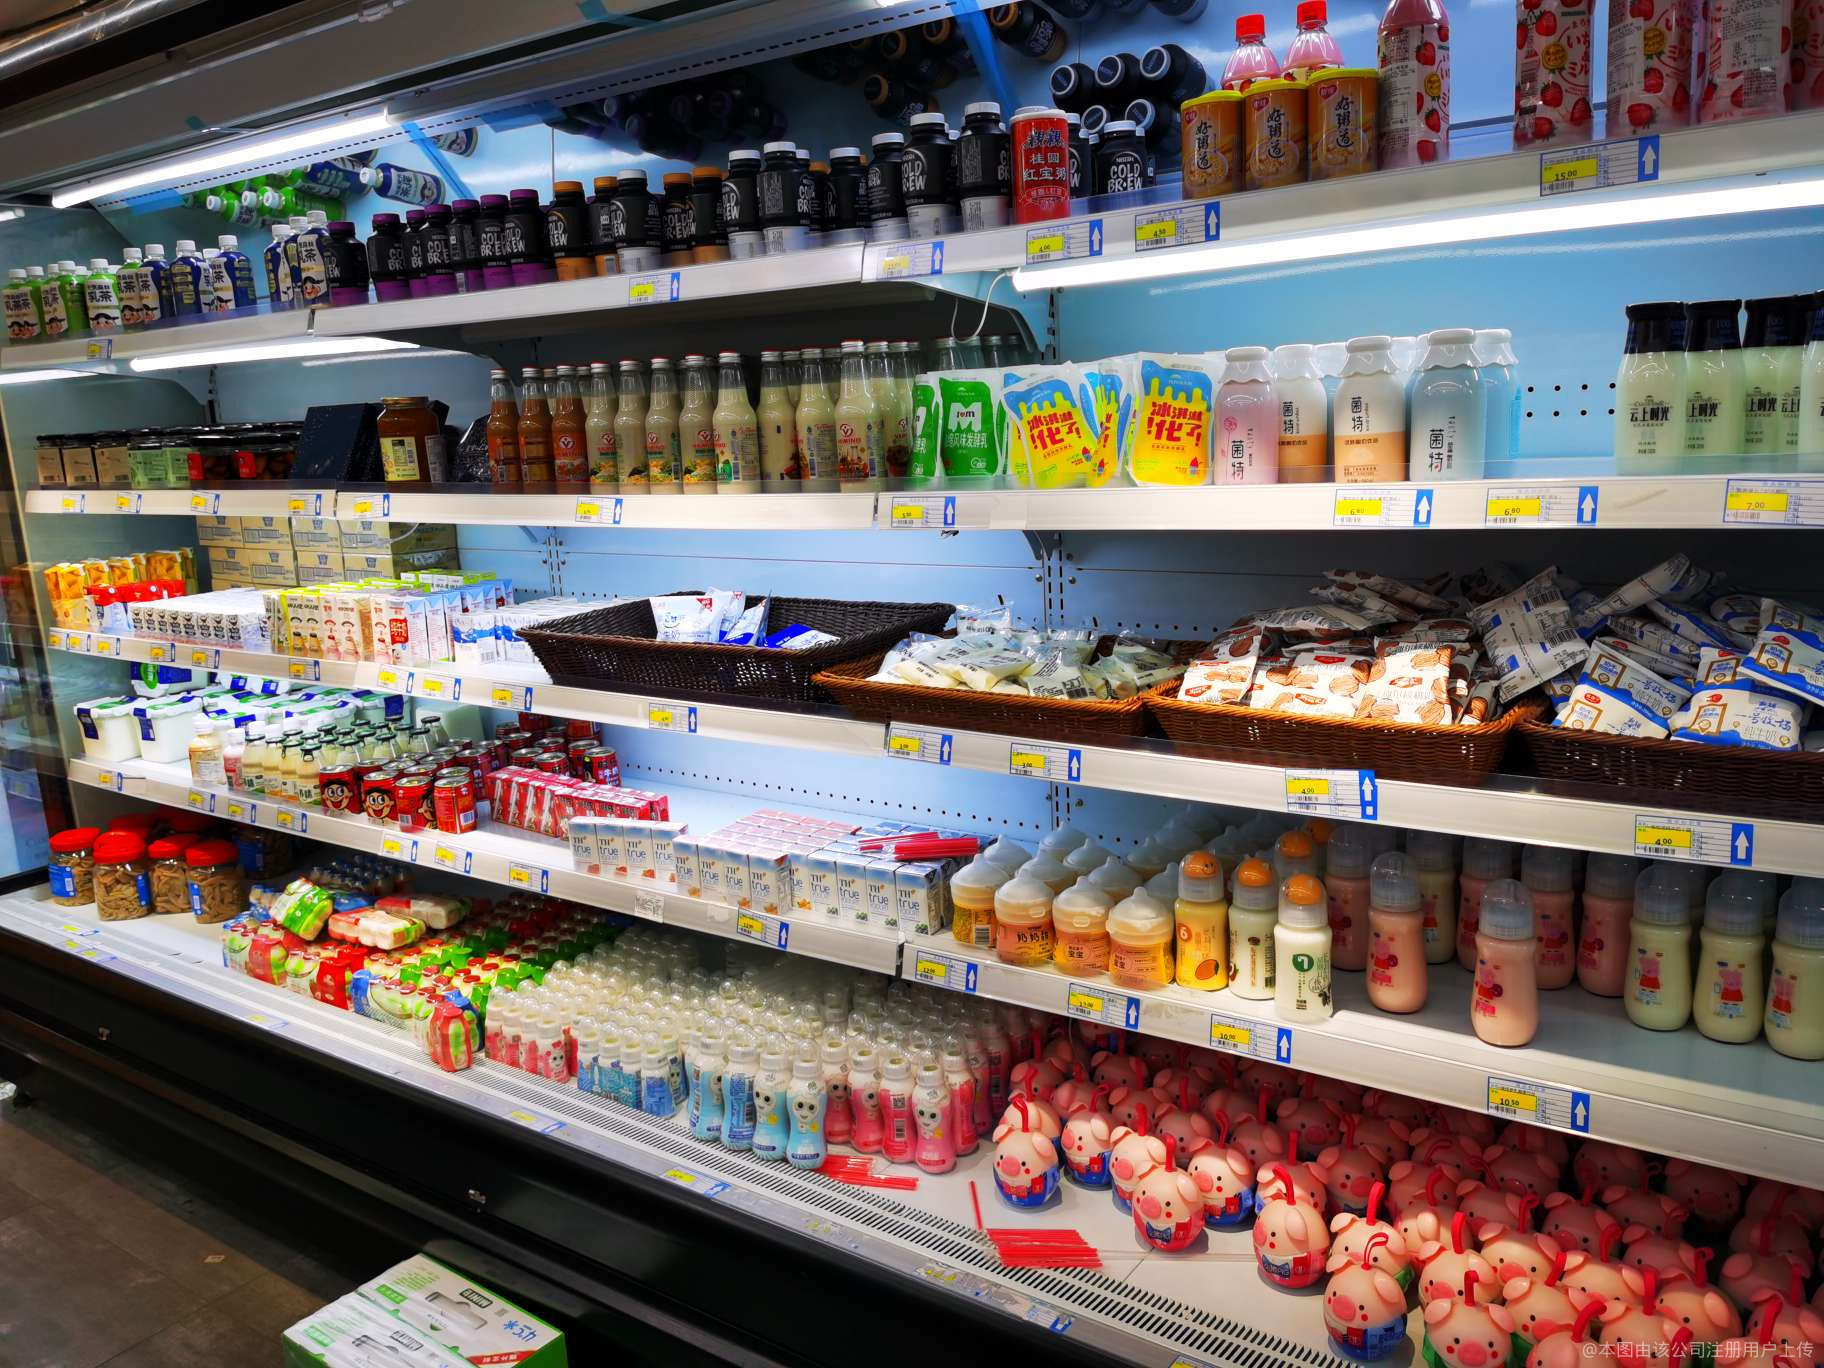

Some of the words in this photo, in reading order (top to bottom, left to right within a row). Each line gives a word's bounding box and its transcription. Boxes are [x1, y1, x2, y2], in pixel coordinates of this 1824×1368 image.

[1110, 164, 1140, 179] COLD
[1554, 170, 1577, 181] 15.00
[549, 221, 564, 234] OLD
[427, 241, 448, 253] COL
[1151, 401, 1203, 421] 冰淇淋
[1688, 402, 1718, 418] 上时光
[1749, 397, 1777, 412] 上时光
[1027, 411, 1074, 432] 冰淇淋
[1630, 407, 1670, 422] 云上时光
[1746, 502, 1765, 511] 7.00
[1655, 838, 1672, 846] 4.00
[1500, 1098, 1519, 1107] 10.50
